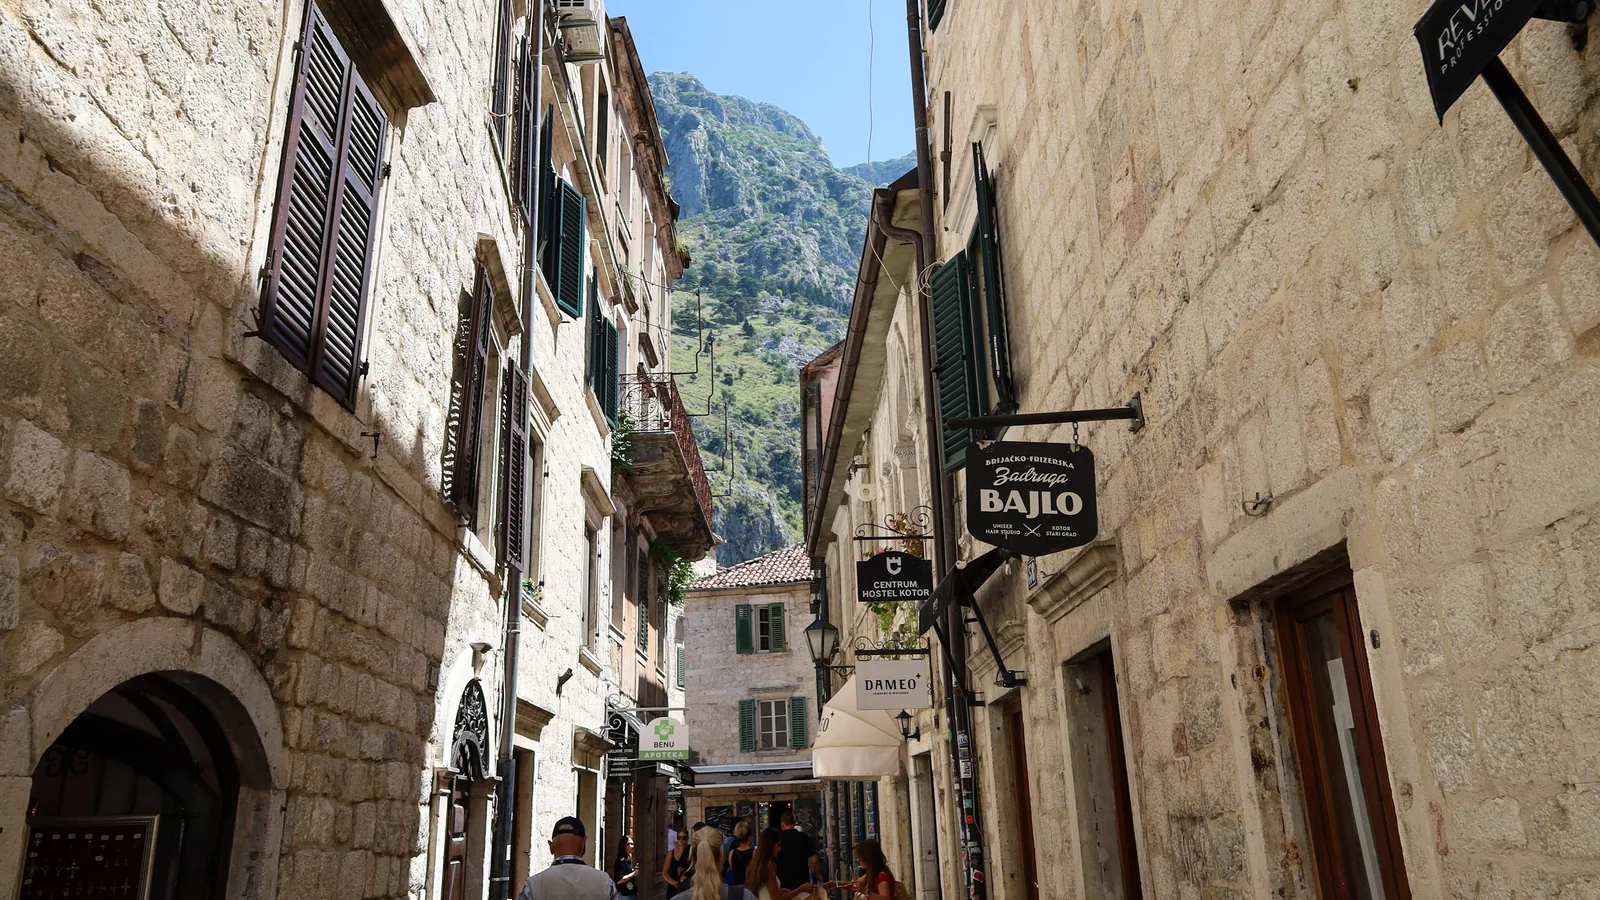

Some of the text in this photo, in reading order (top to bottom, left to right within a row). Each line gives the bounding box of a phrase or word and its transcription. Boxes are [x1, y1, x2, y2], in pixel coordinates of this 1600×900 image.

[1442, 0, 1509, 74] PROFESSIO
[985, 454, 1075, 470] BRIJAČKO-FRIZERSKA
[993, 466, 1069, 488] Zadruga
[980, 489, 1083, 519] BAJLO
[873, 580, 918, 589] CENTRUM
[862, 589, 930, 598] HOSTEL KOTOR
[865, 678, 917, 691] DAMEO
[644, 751, 684, 759] APOTEKA
